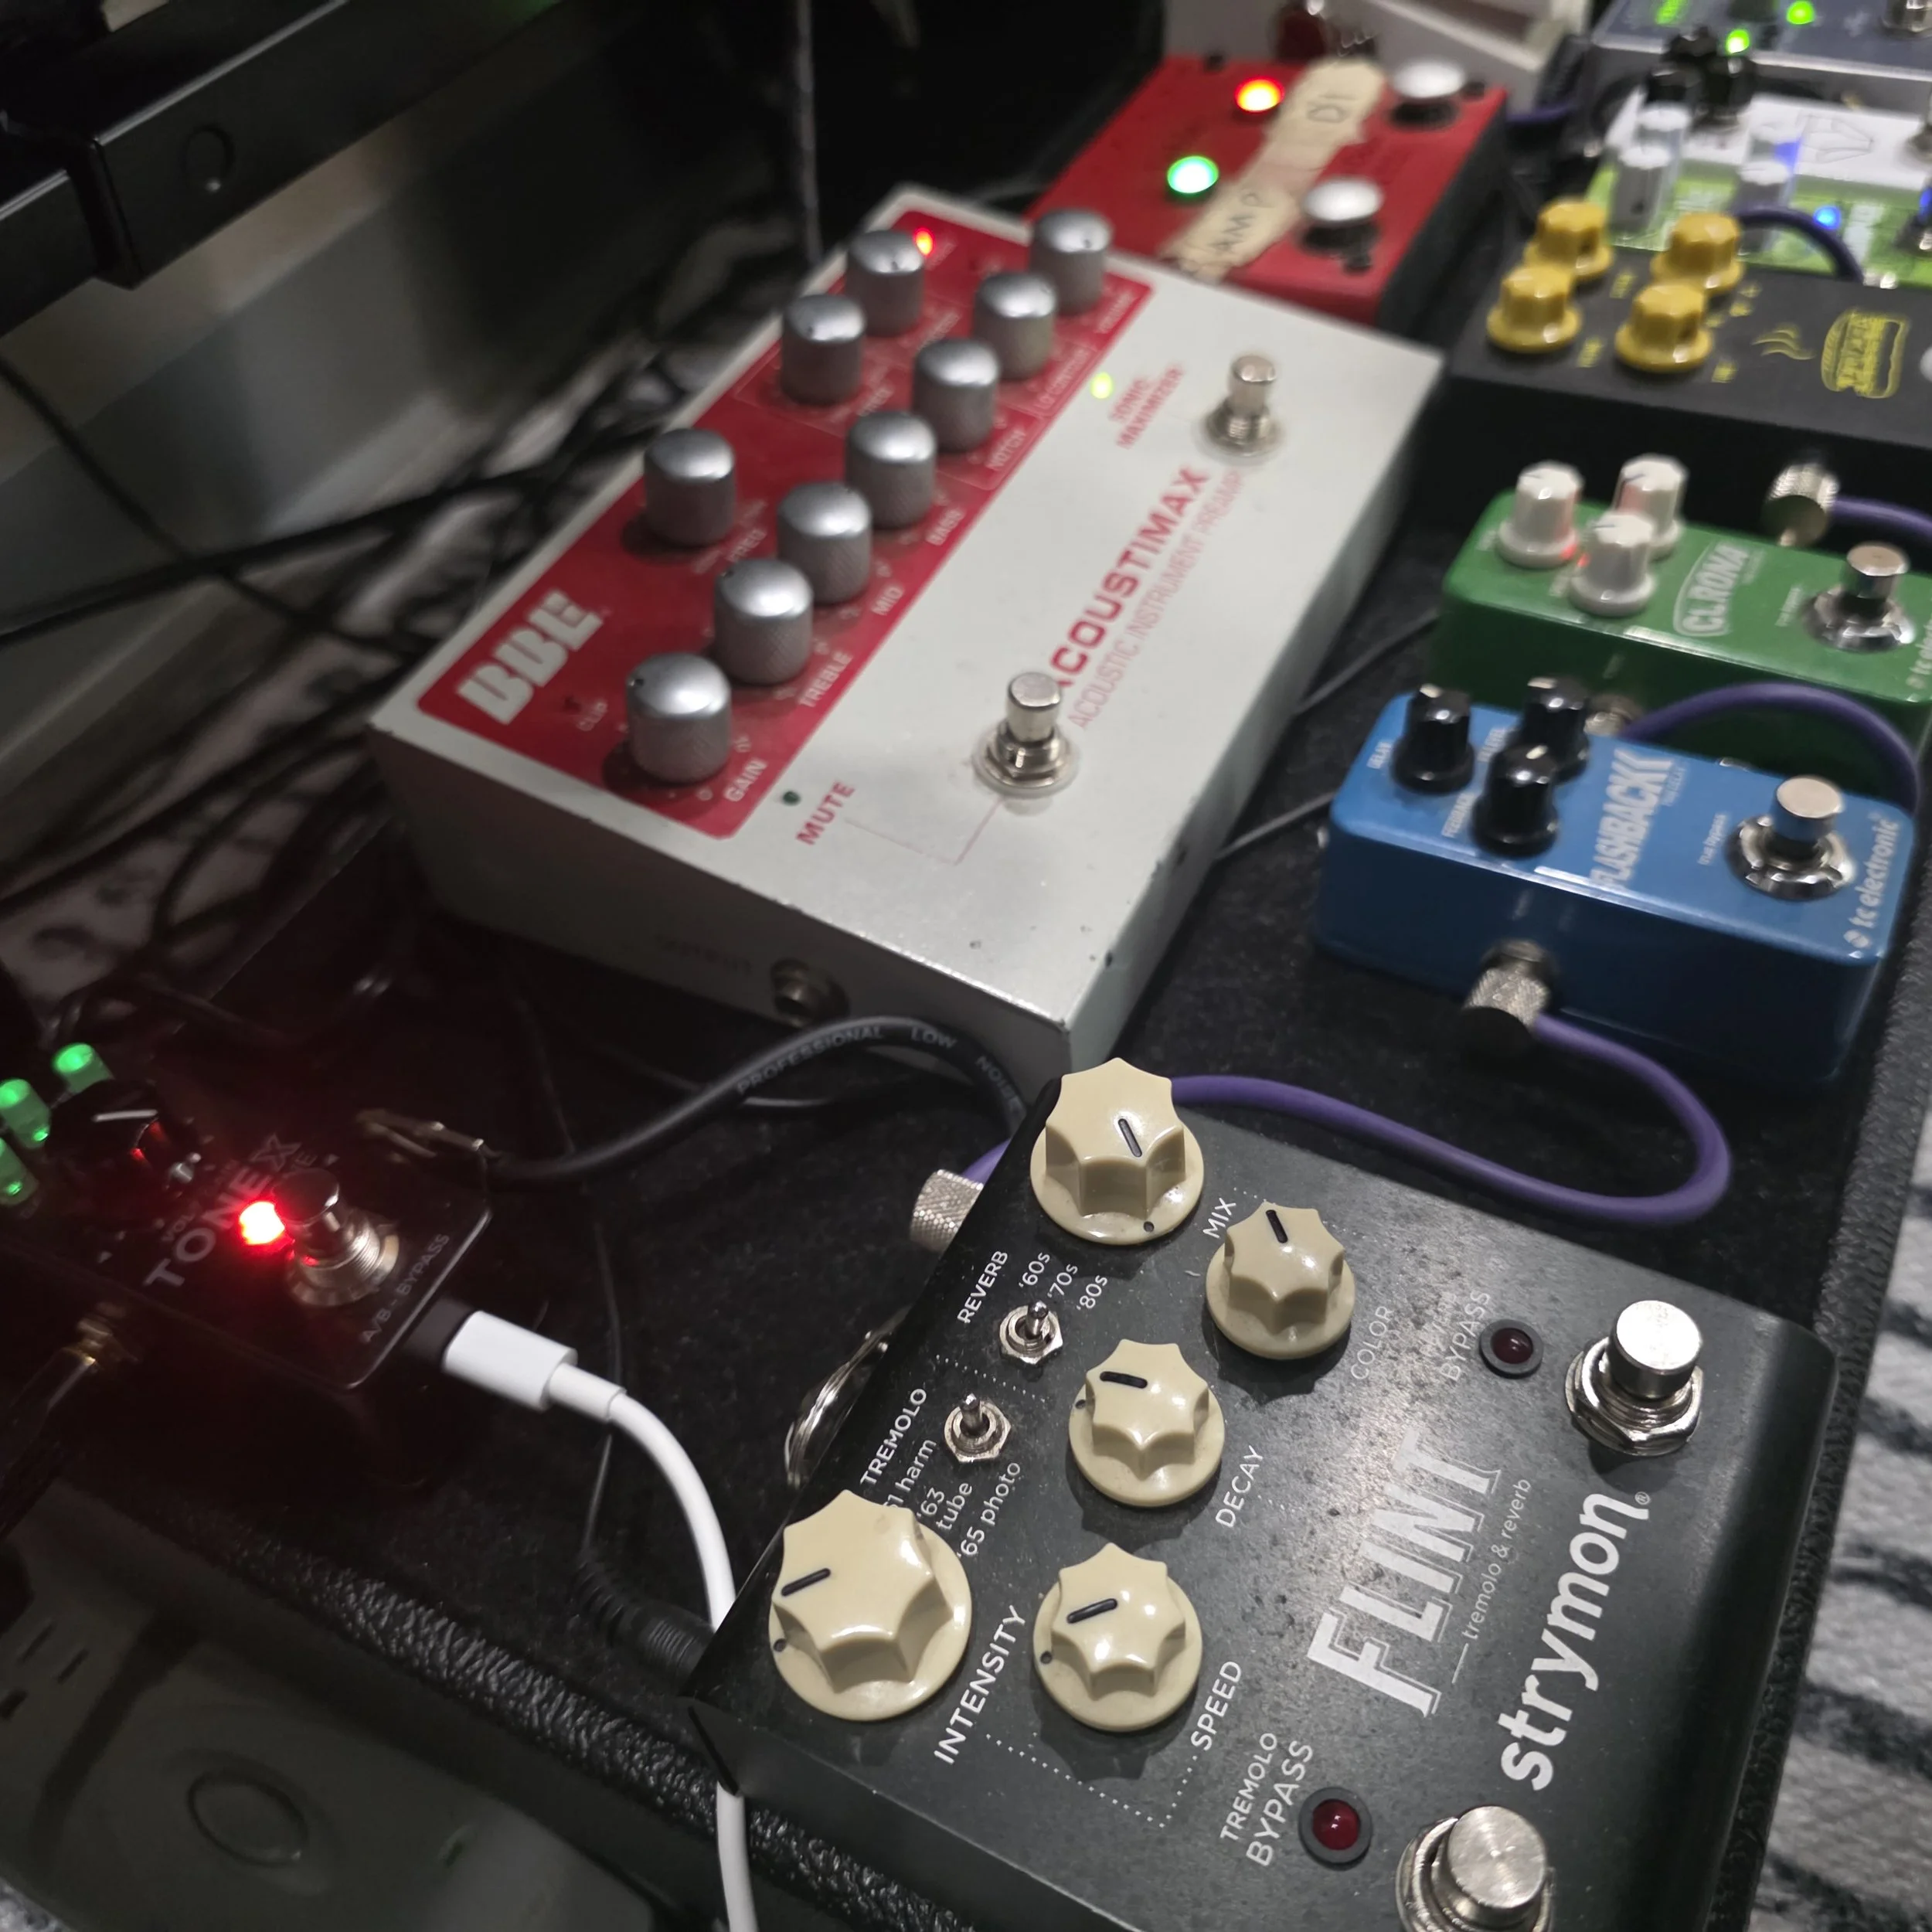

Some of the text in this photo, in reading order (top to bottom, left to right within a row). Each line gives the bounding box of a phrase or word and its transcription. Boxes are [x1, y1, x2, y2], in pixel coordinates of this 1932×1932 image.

[457, 591, 603, 726] BBE
[1068, 639, 1139, 730] ACOUSTIC
[1125, 533, 1204, 639] INSTRUMENT
[798, 651, 852, 707] TREBLE
[723, 758, 767, 801] GAIN
[795, 781, 855, 845] MUTE
[1848, 818, 1900, 928] tc electronic
[737, 1026, 885, 1094] PROFESSIONAL
[911, 1026, 957, 1049] LOW
[1202, 1198, 1236, 1238] MIX
[396, 1234, 450, 1294] BYPASS
[957, 1250, 1008, 1323] REVERB
[1351, 1307, 1393, 1379] COLOR
[1439, 1290, 1490, 1381] BYPASS
[860, 1389, 926, 1485] TREMOLO
[895, 1439, 937, 1492] harm
[936, 1483, 972, 1531] tube
[981, 1463, 1020, 1526] photo
[1216, 1446, 1264, 1528] DECAY
[1307, 1430, 1501, 1717] FLINT
[1462, 1479, 1531, 1640] tremolo & reverb
[934, 1604, 1027, 1764] INTENSITY
[1192, 1661, 1241, 1752] SPEED
[1219, 1733, 1277, 1845] TREMOLO
[1245, 1740, 1313, 1867] BYPASS
